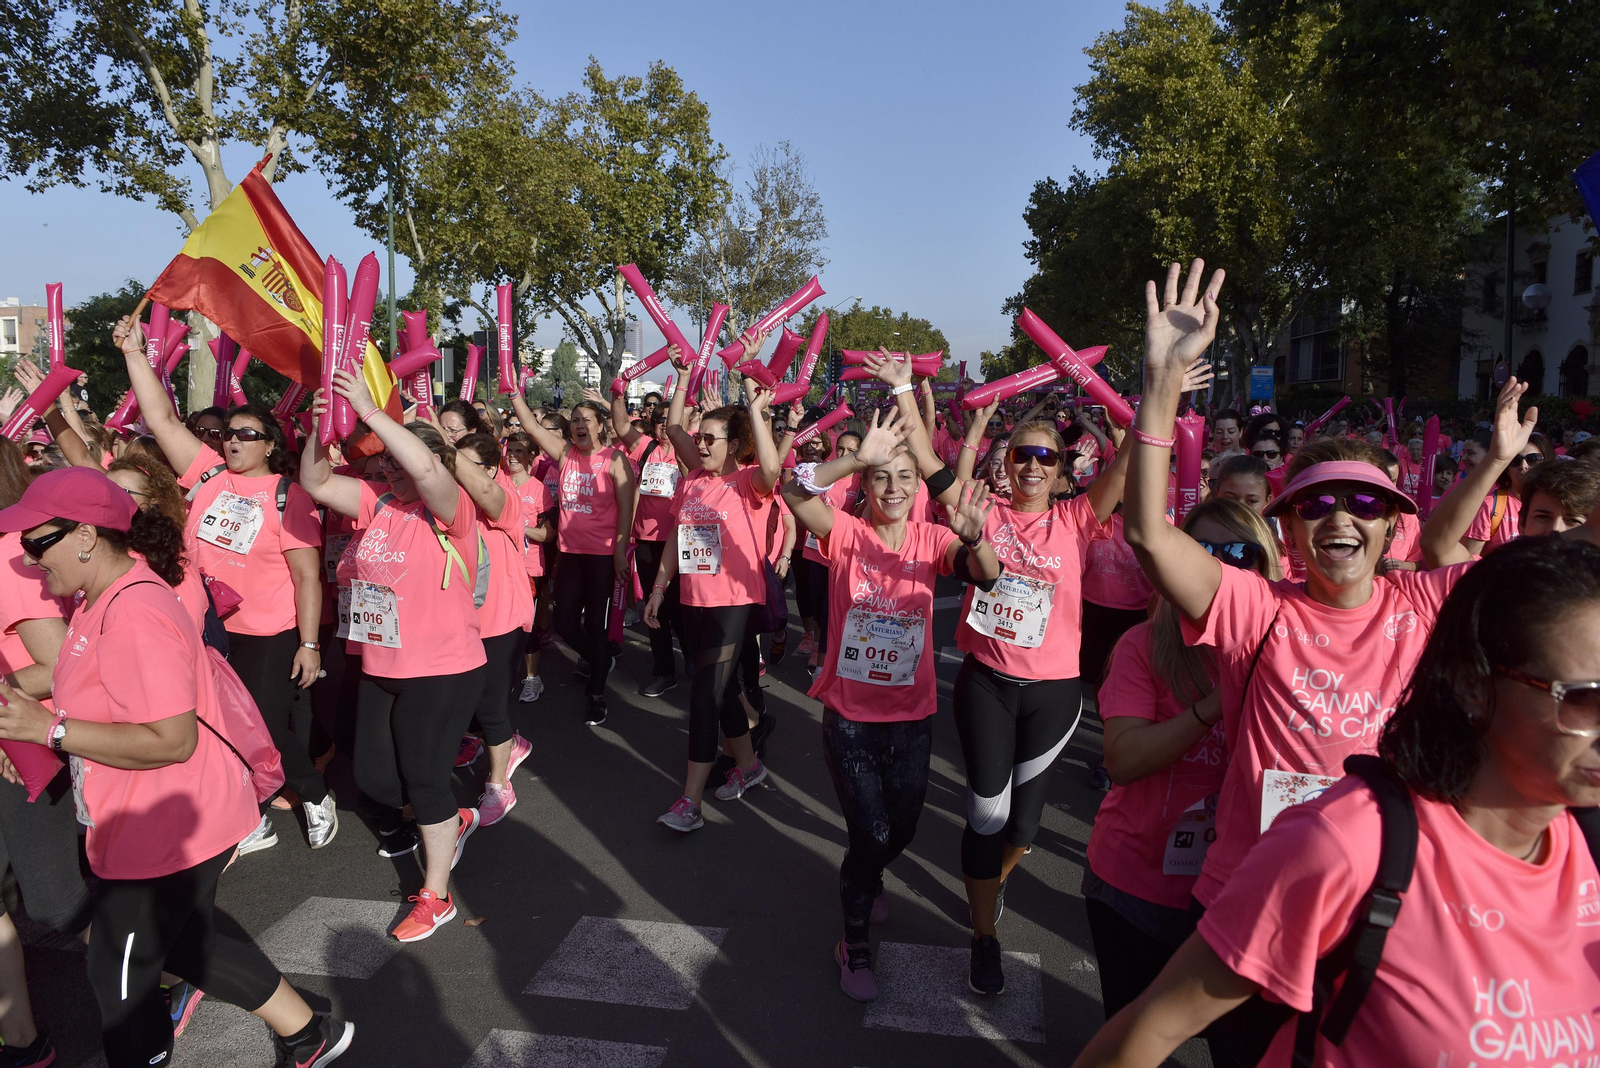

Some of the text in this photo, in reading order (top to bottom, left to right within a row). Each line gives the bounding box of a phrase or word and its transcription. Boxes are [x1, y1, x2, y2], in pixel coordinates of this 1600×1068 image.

[501, 323, 511, 351] Ladival
[697, 340, 714, 368] Ladival
[624, 359, 647, 380] Ladival
[803, 353, 819, 381] Ladival
[1056, 352, 1093, 388] Ladival
[649, 477, 665, 486] 016
[219, 518, 242, 532] 016
[693, 510, 728, 521] CHICAS
[693, 547, 712, 557] 016
[1011, 549, 1061, 569] CHICAS
[855, 579, 882, 595] HOY
[998, 581, 1030, 596] ASTURIANA
[852, 592, 898, 611] GANAN
[363, 611, 383, 625] 016
[992, 602, 1025, 622] 016
[869, 623, 903, 636] ASTURIANA
[997, 618, 1014, 629] 3413
[1275, 625, 1330, 647] OYSHO
[865, 646, 899, 663] 016
[870, 662, 889, 671] 3414
[1292, 667, 1345, 691] HOY
[1291, 689, 1382, 715] GANAN
[1287, 709, 1333, 738] LAS
[1340, 707, 1397, 739] CHIC
[1182, 747, 1223, 767] LAS
[1169, 858, 1198, 867] OYSHO
[1469, 1013, 1595, 1062] GANAN
